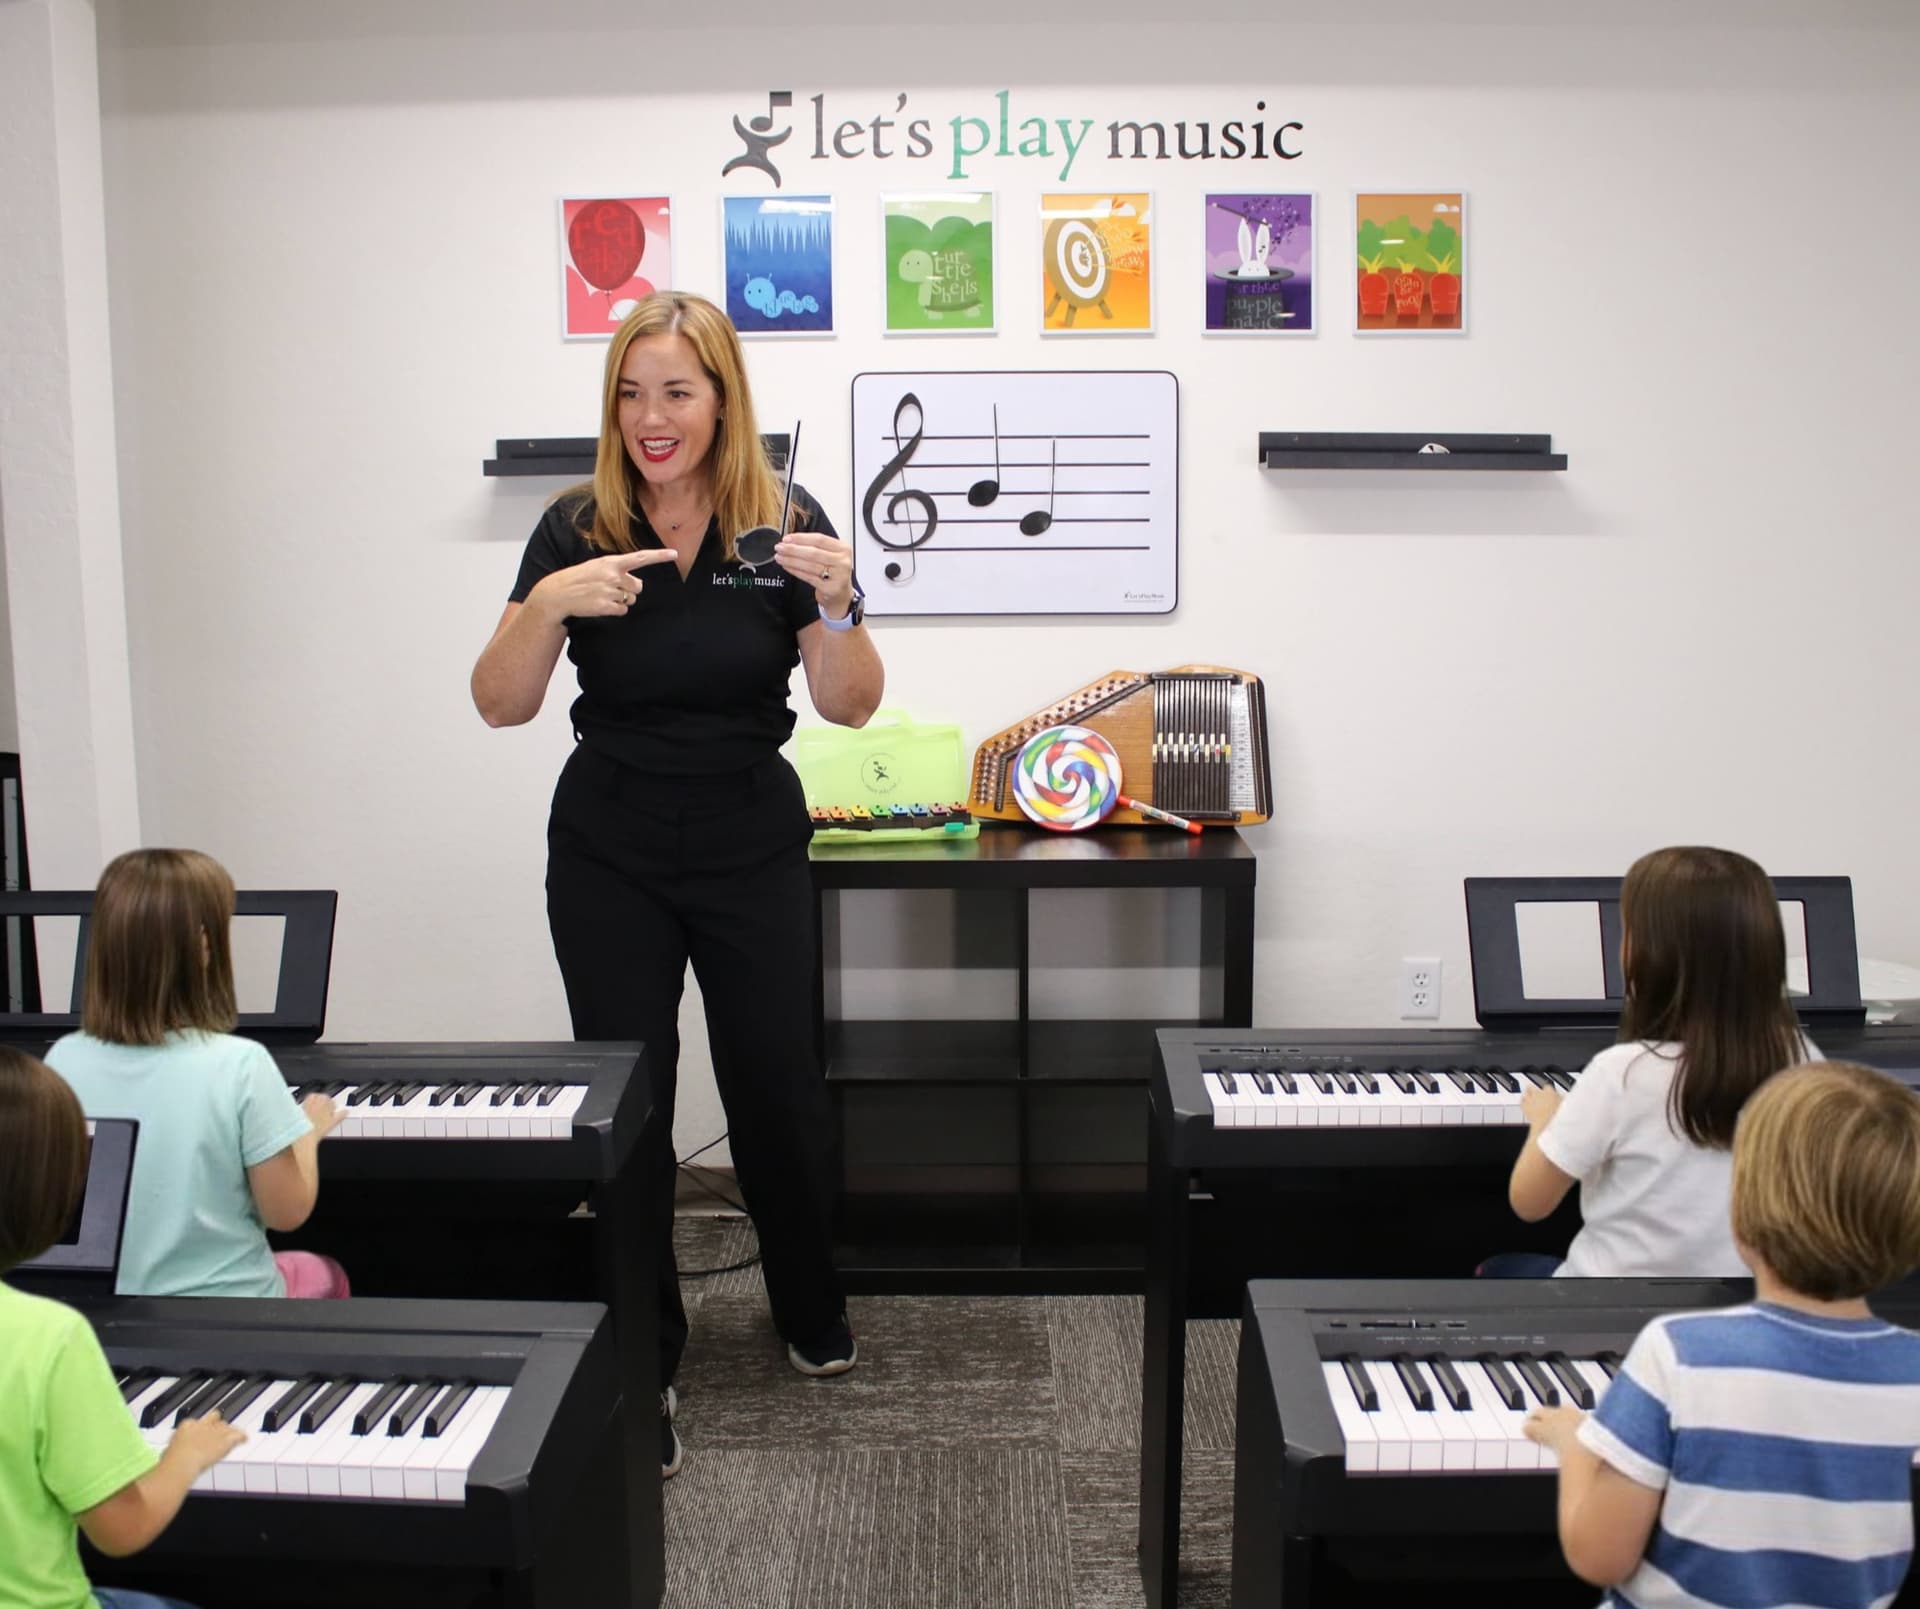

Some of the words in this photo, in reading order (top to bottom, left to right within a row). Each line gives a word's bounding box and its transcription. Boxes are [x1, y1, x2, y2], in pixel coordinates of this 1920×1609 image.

[811, 92, 933, 158] let's
[947, 89, 1095, 181] play
[1107, 101, 1304, 160] music
[712, 572, 733, 585] let's
[754, 575, 785, 588] music
